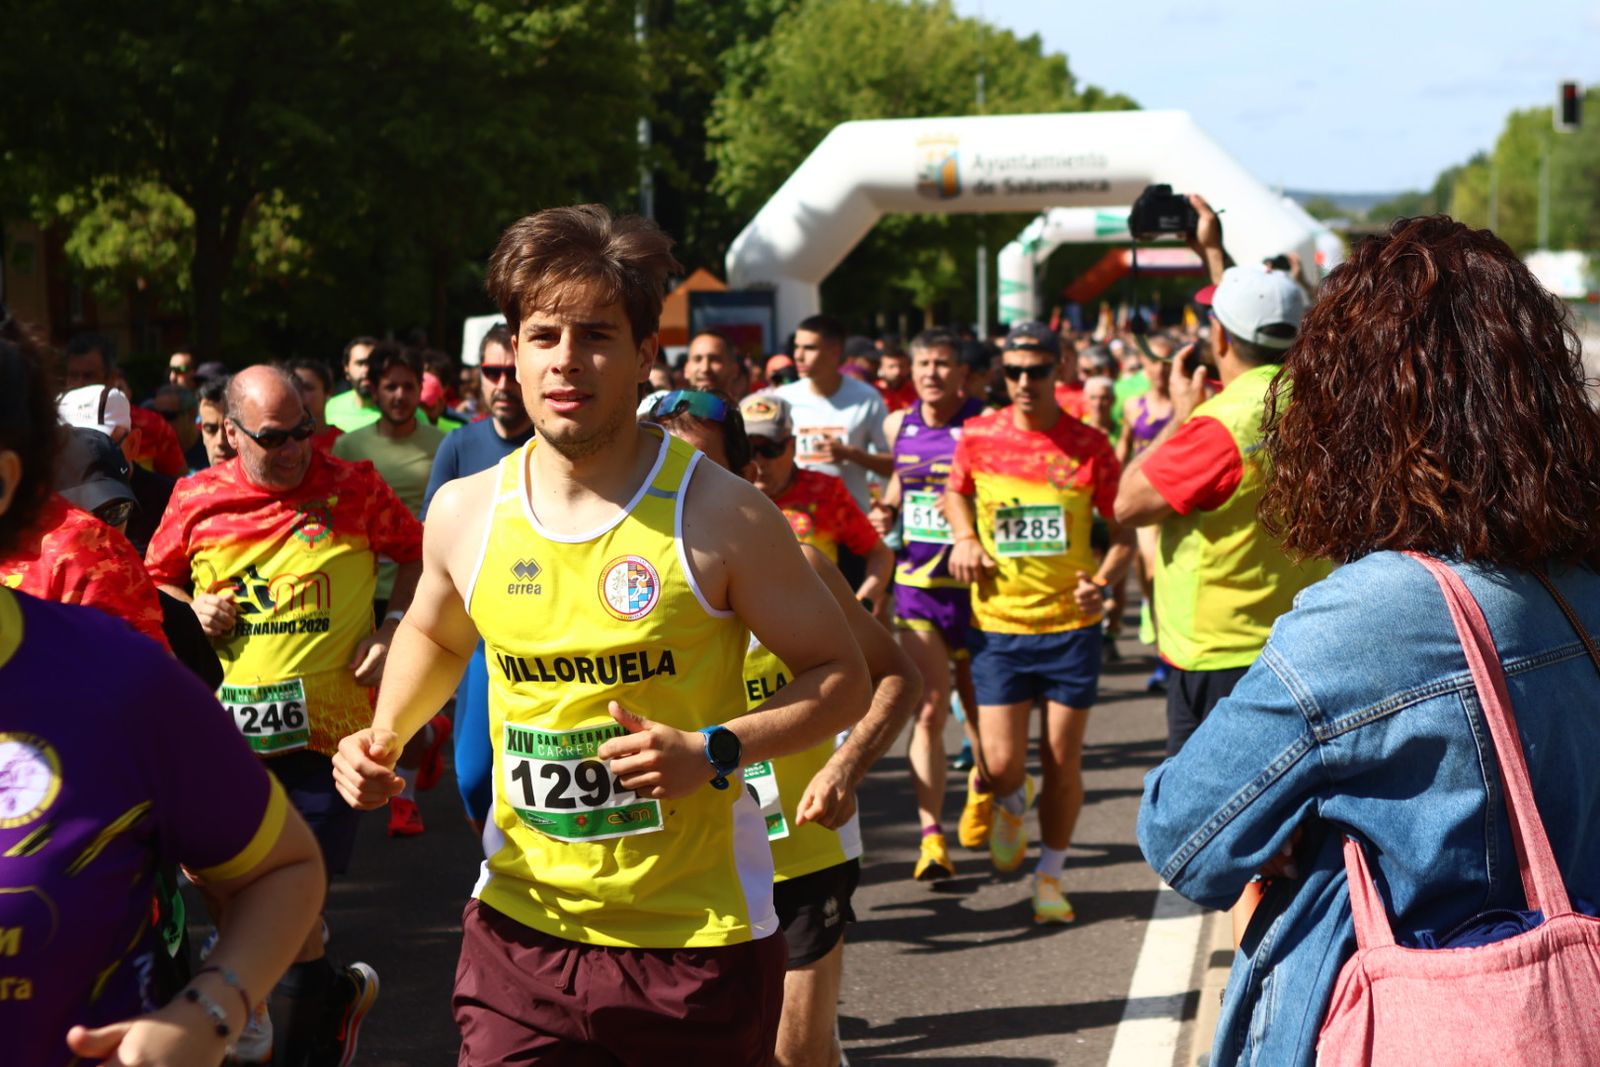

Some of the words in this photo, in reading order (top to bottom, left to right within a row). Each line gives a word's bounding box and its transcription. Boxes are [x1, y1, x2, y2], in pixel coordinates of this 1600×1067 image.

[973, 153, 1108, 175] Ayuntamiento
[972, 179, 997, 195] de
[1003, 178, 1111, 195] Salamanca
[999, 518, 1061, 540] 1285
[507, 582, 542, 595] errea
[496, 649, 676, 686] VILLORUELA
[507, 728, 534, 754] XIV
[537, 734, 559, 746] SAN
